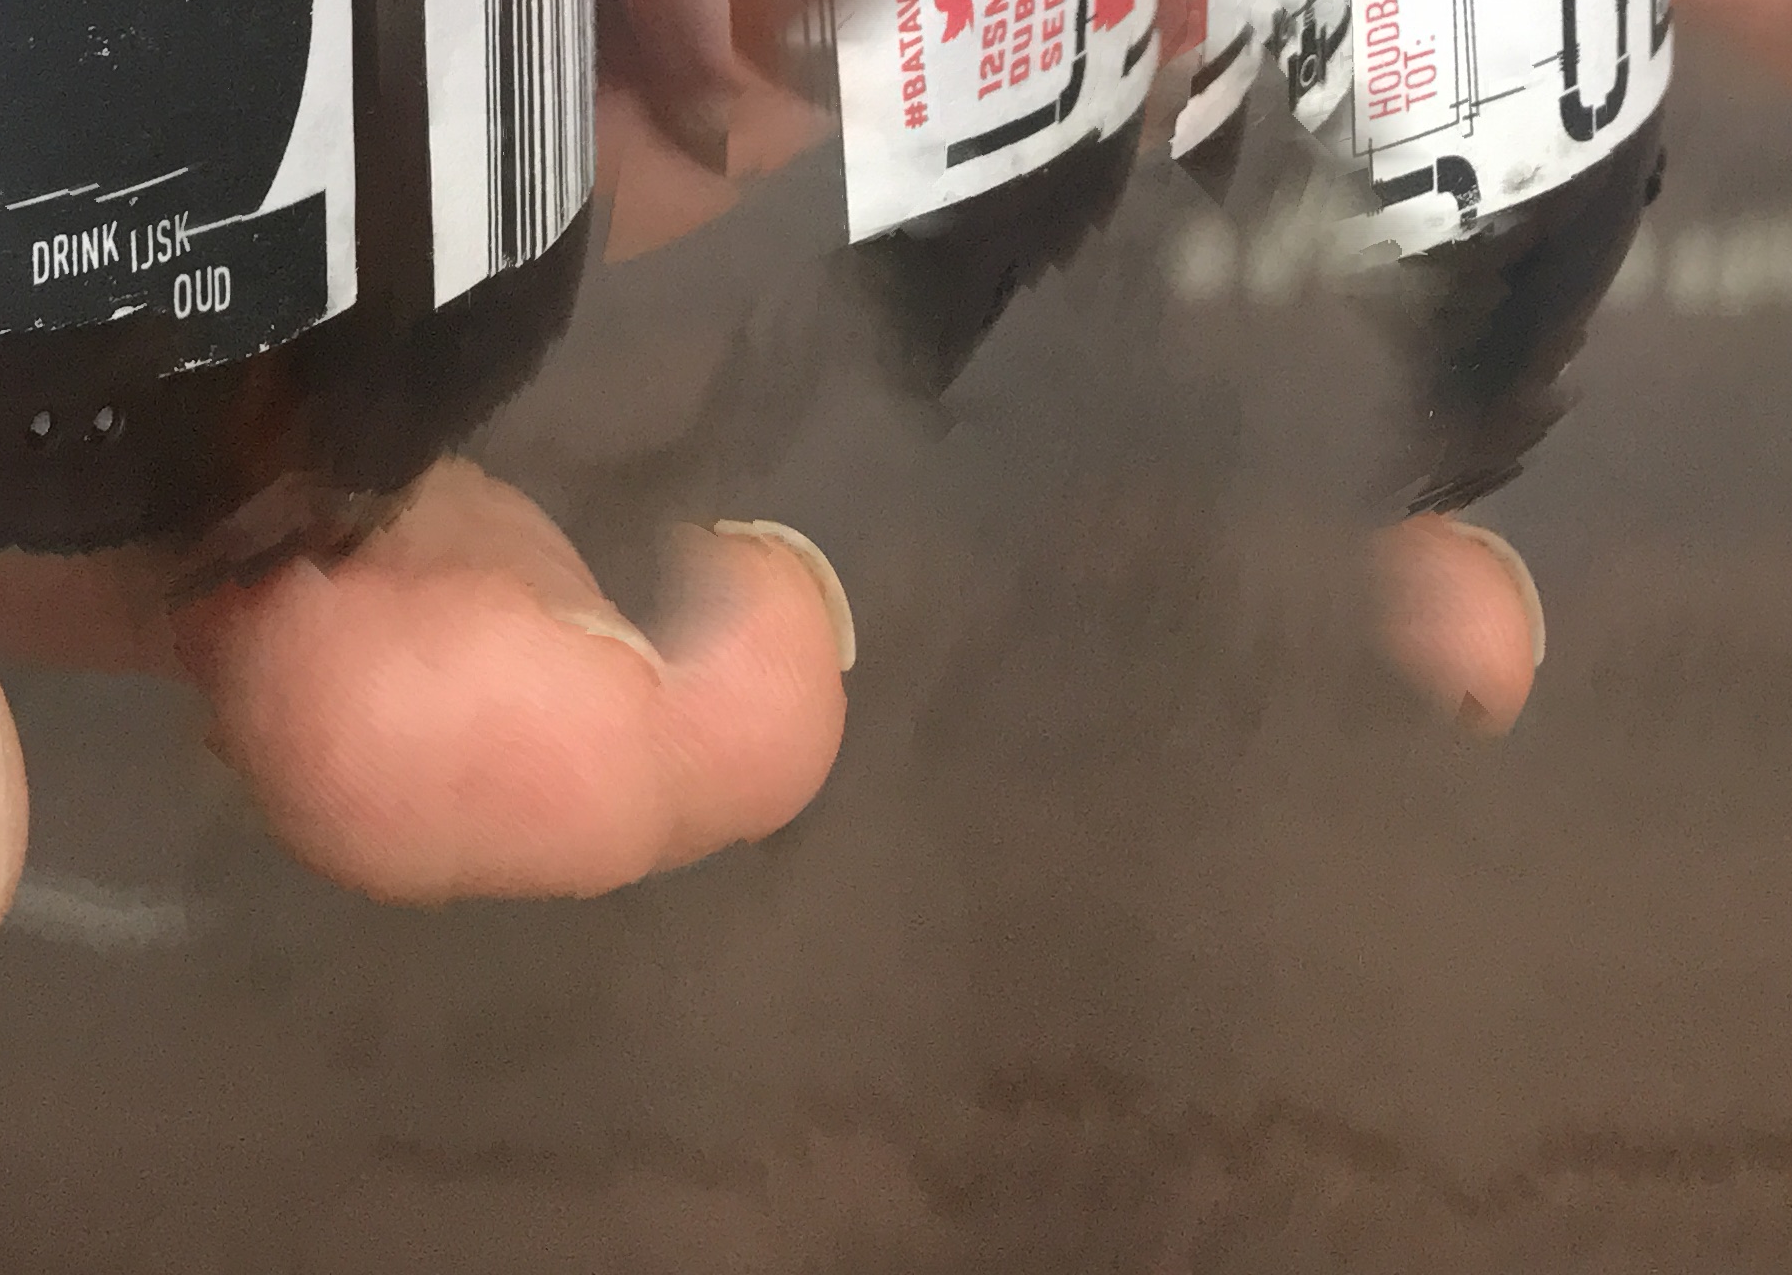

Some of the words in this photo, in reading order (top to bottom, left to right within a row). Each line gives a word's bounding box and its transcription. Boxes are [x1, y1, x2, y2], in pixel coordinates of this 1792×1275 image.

[1403, 34, 1437, 113] TOT:
[32, 220, 119, 286] DRINK
[173, 265, 231, 320] OUD
